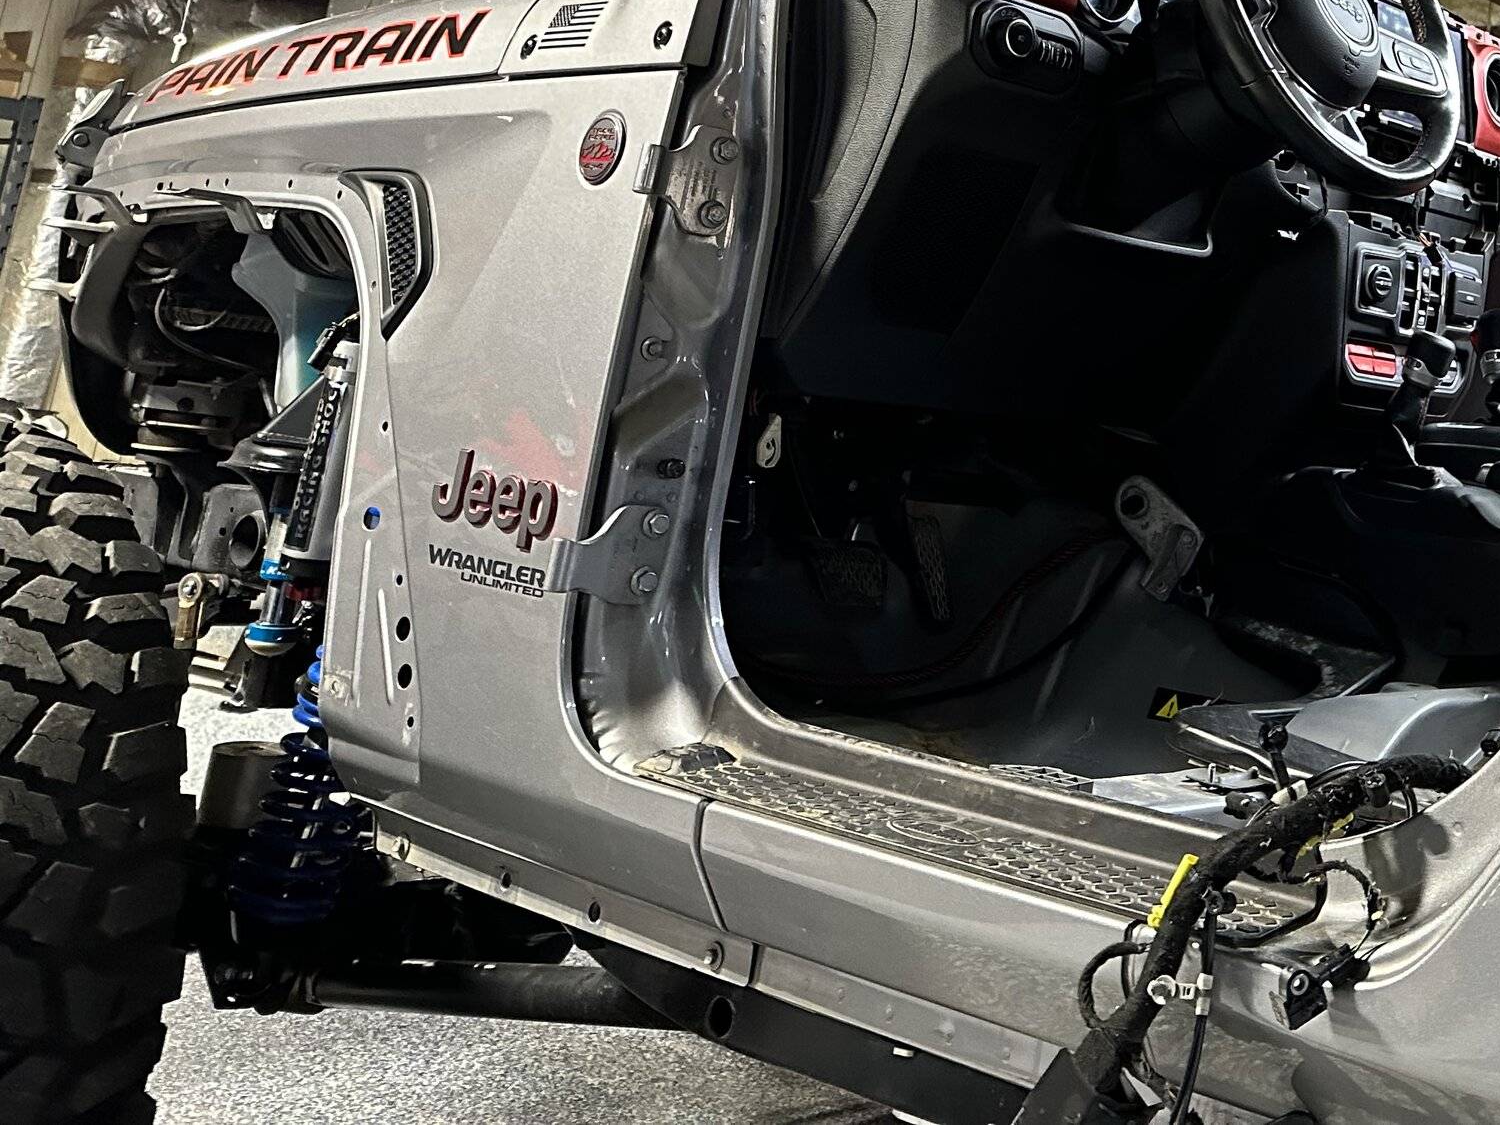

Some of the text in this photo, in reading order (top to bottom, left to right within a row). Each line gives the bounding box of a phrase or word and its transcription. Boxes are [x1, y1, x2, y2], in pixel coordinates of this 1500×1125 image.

[145, 8, 493, 104] PAIN TRAIN
[432, 448, 559, 553] Jeep
[428, 543, 546, 588] WRANGLER
[460, 571, 545, 598] UNLIMITED
